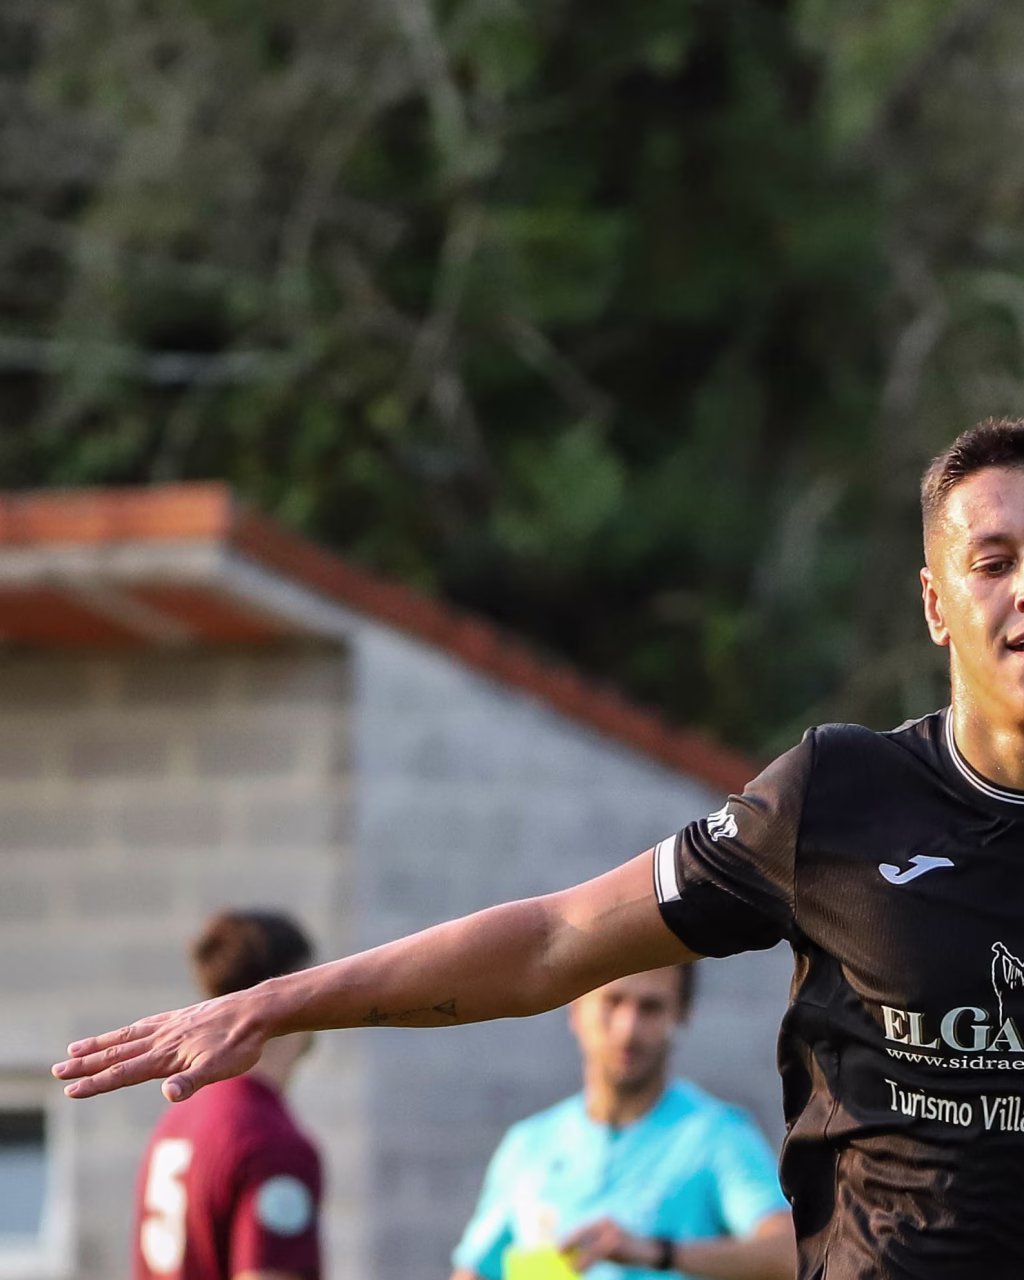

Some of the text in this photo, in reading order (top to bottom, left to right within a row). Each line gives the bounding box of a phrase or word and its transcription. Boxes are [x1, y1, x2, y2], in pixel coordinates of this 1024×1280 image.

[881, 1005, 940, 1049] EL
[884, 1078, 973, 1127] Turismo
[141, 1138, 192, 1273] 5
